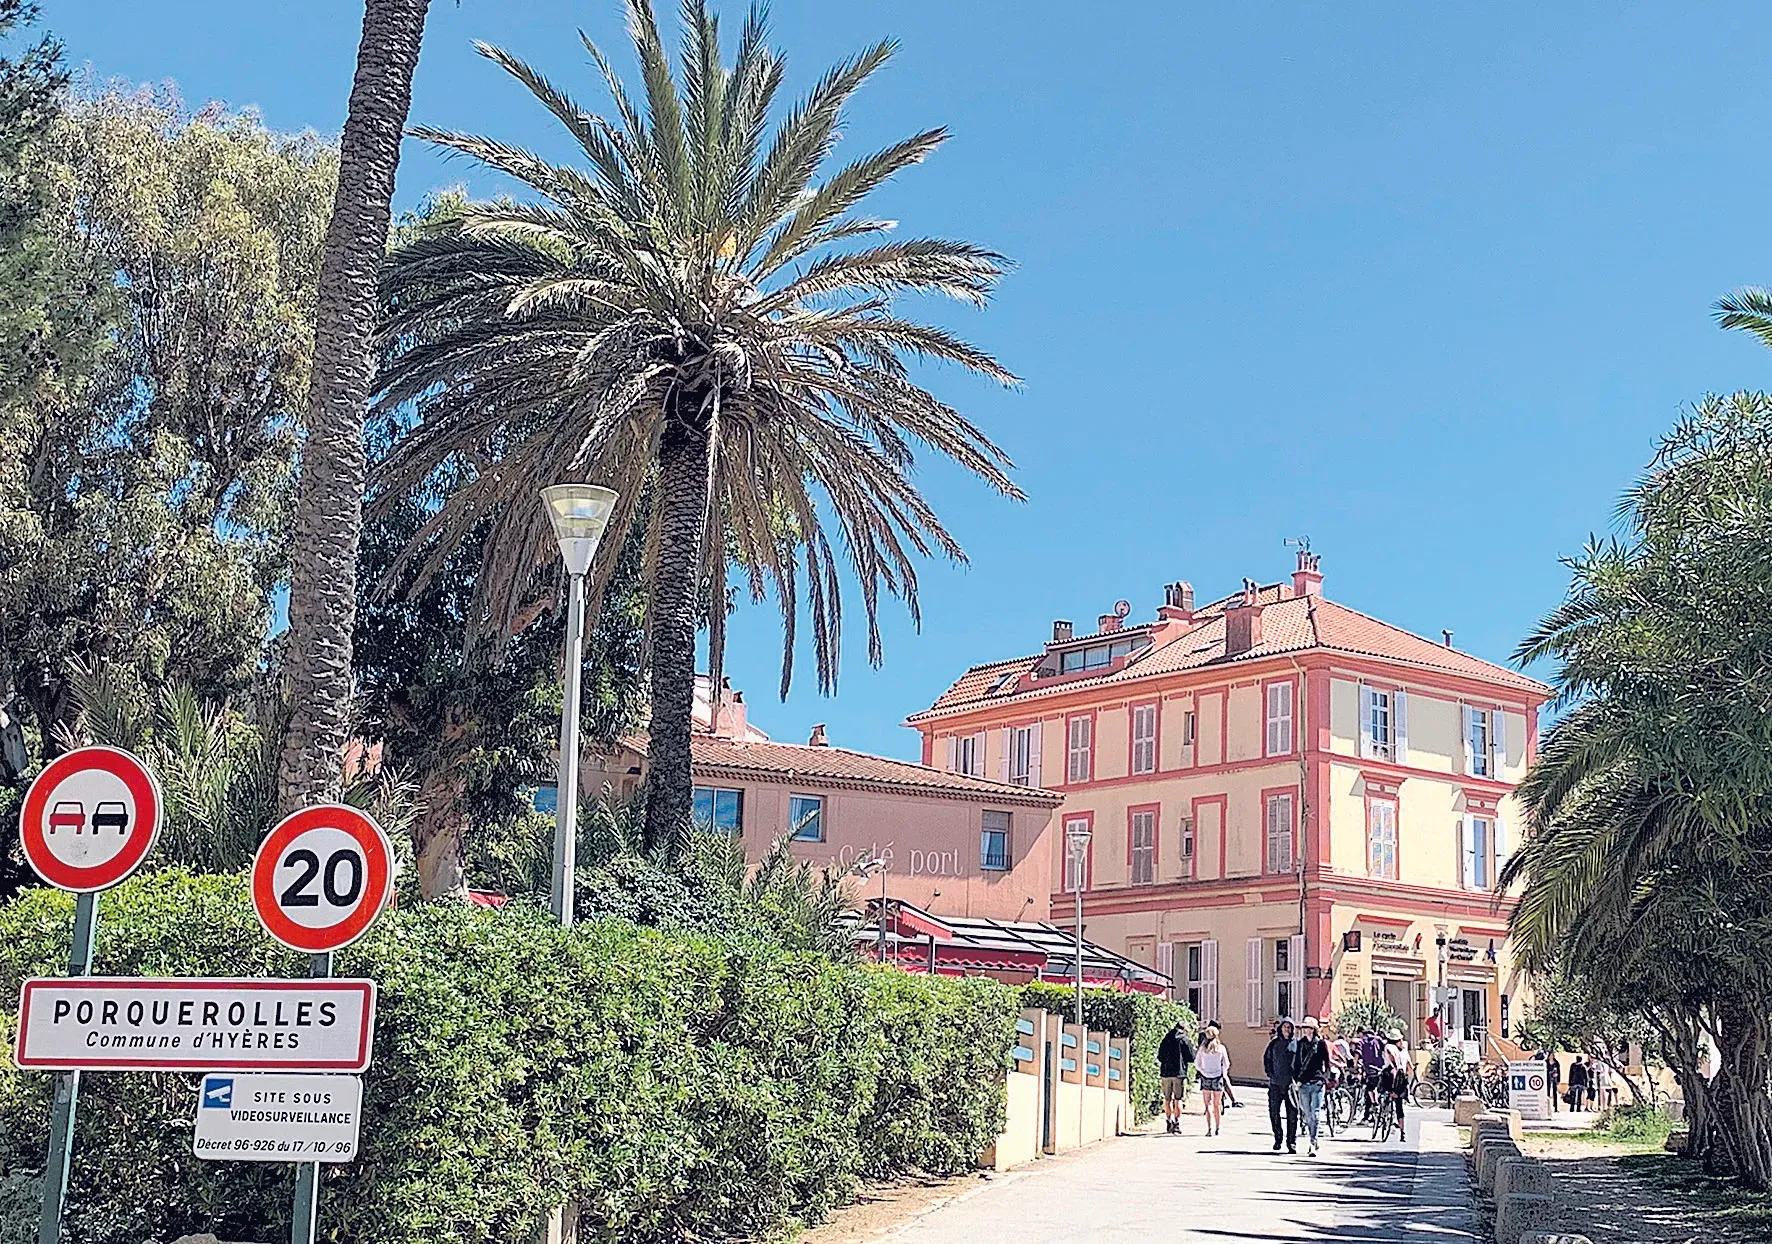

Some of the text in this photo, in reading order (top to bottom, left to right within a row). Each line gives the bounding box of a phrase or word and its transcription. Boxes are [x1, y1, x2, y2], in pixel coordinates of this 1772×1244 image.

[909, 847, 964, 878] port
[280, 848, 363, 908] 20
[53, 1000, 337, 1027] PORQUEROLLES
[86, 1028, 300, 1049] Commune d'HYÈRES
[1532, 1079, 1541, 1087] 10
[253, 1091, 332, 1104] SITE SOUS
[230, 1110, 352, 1124] VIDEOSURVEILLANCE
[196, 1138, 351, 1154] Décret 96-926 du 17/10/96
